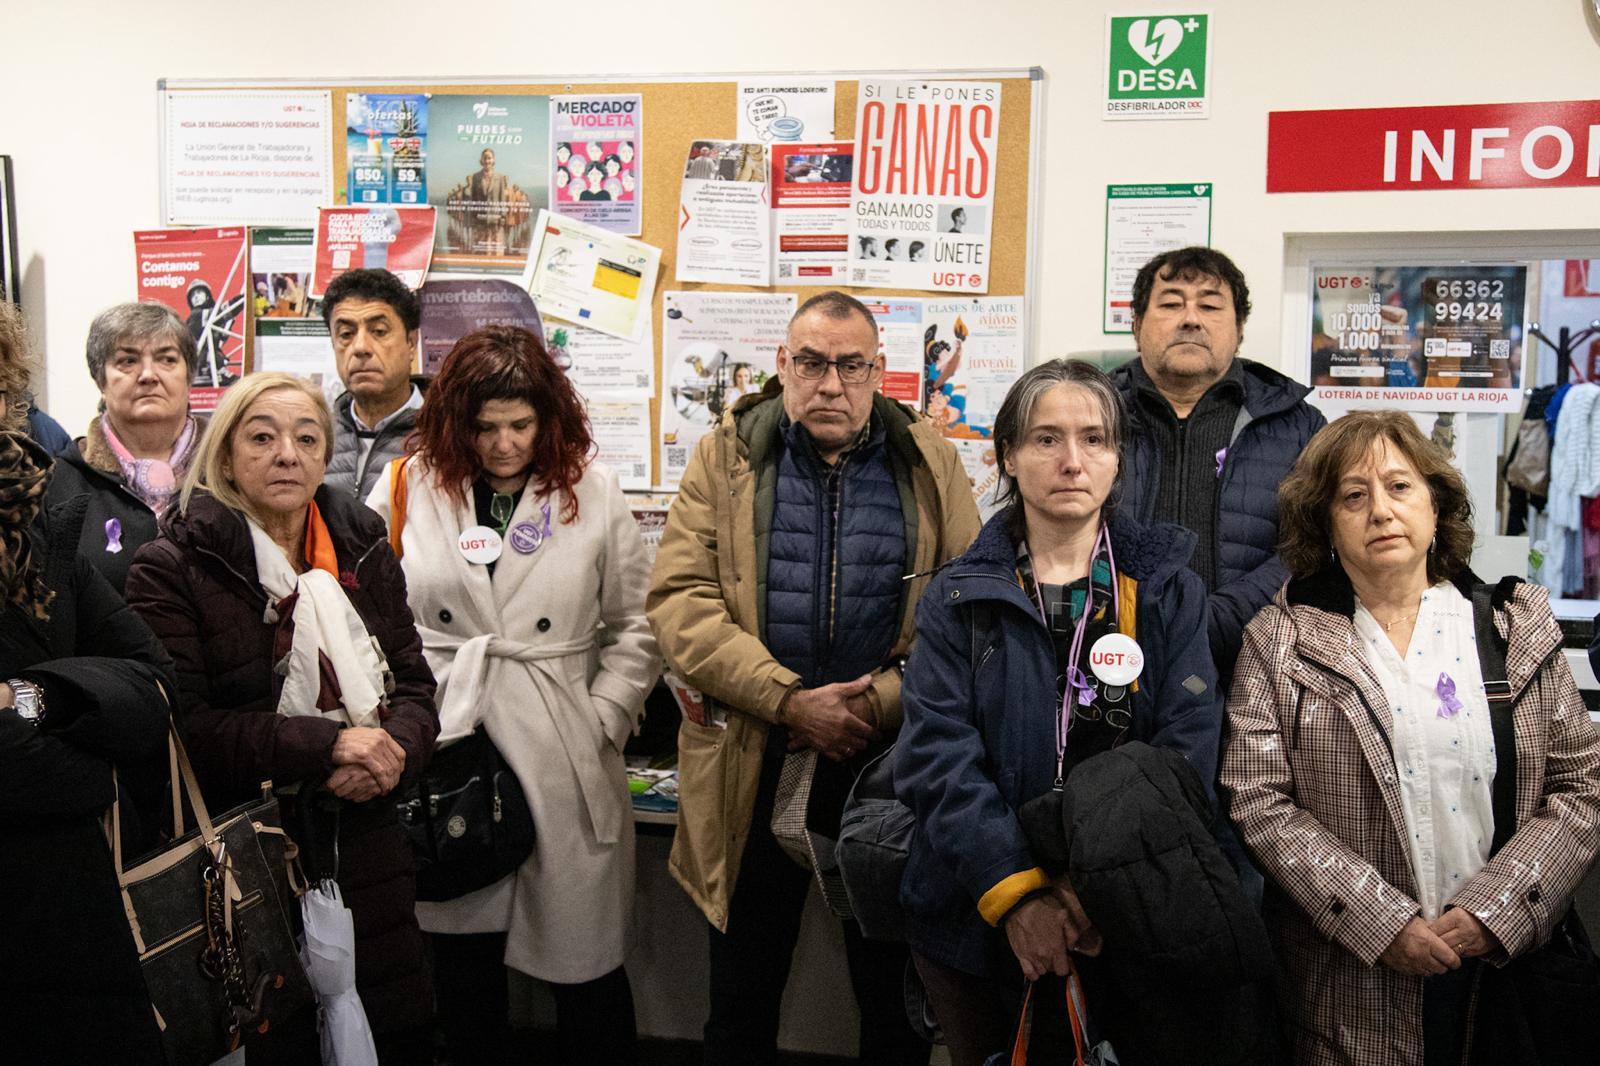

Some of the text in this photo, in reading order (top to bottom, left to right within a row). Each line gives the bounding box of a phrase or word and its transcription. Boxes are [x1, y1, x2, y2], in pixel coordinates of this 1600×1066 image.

[1117, 68, 1198, 92] DESA
[864, 84, 995, 101] SI LE PONES
[557, 101, 637, 114] MERCADO
[1107, 101, 1186, 111] DESFIBRILADOR
[367, 108, 413, 121] ofertas
[570, 114, 635, 128] VIOLETA
[457, 124, 507, 134] PUEDES
[217, 143, 246, 151] General
[472, 135, 523, 145] FUTURO
[858, 101, 993, 199] GANAS
[856, 200, 935, 219] GANAMOS
[857, 218, 889, 230] TODAS
[891, 219, 897, 229] Y
[934, 236, 984, 265] ÚNETE
[141, 260, 200, 273] Contamos
[141, 273, 186, 289] contigo
[933, 271, 966, 287] UGT
[1318, 276, 1348, 289] UGT
[421, 286, 523, 304] invertebrados
[1435, 279, 1504, 299] 66362
[1368, 292, 1381, 304] ya
[928, 303, 1016, 313] CLASES DE ARTE
[1346, 303, 1381, 314] somos
[1434, 301, 1503, 321] 99424
[1330, 312, 1382, 331] 10.000
[1338, 331, 1380, 351] 1.000
[1318, 388, 1509, 404] LOTERÍA DE NAVIDAD UGT LA RIOJA
[460, 538, 487, 550] UGT
[1092, 652, 1125, 666] UGT
